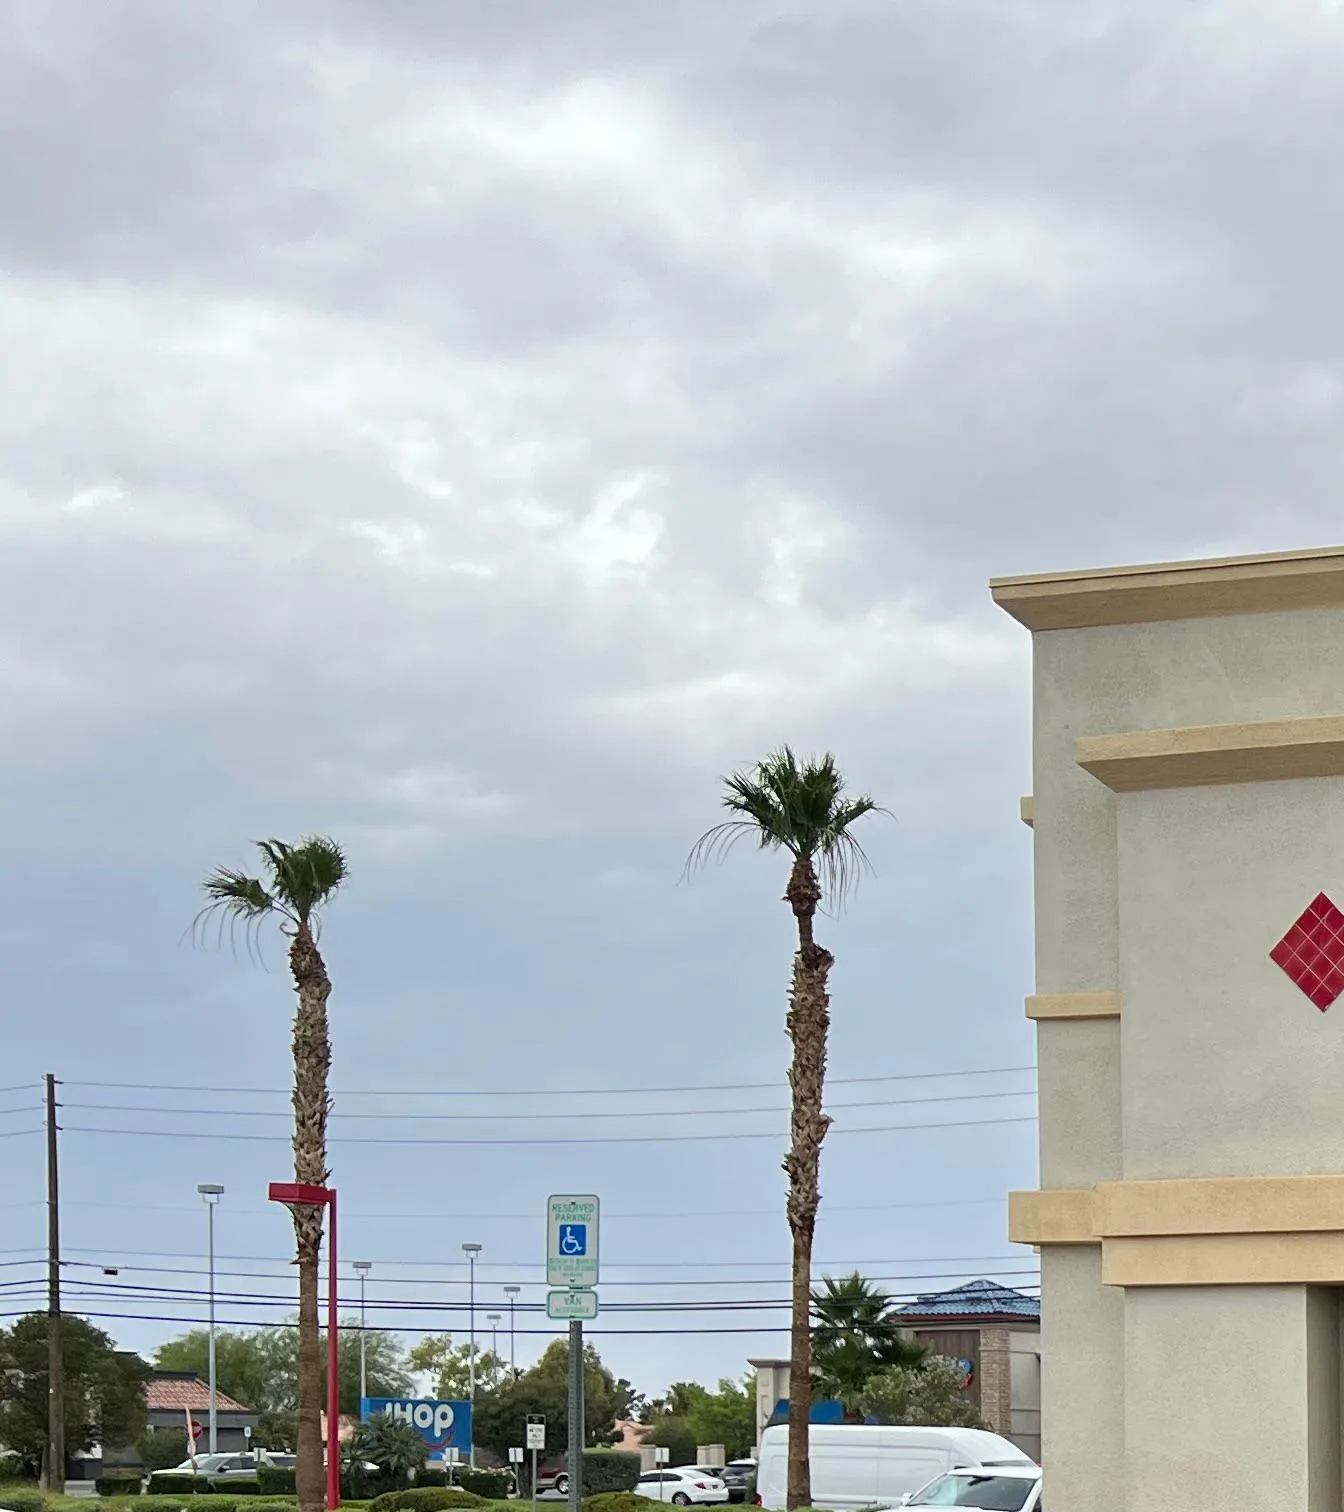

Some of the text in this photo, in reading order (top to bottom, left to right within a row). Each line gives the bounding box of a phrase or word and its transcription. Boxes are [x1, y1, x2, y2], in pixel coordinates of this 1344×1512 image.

[551, 1203, 595, 1213] RESERVED
[555, 1213, 591, 1222] PARKING
[564, 1297, 582, 1305] VAN
